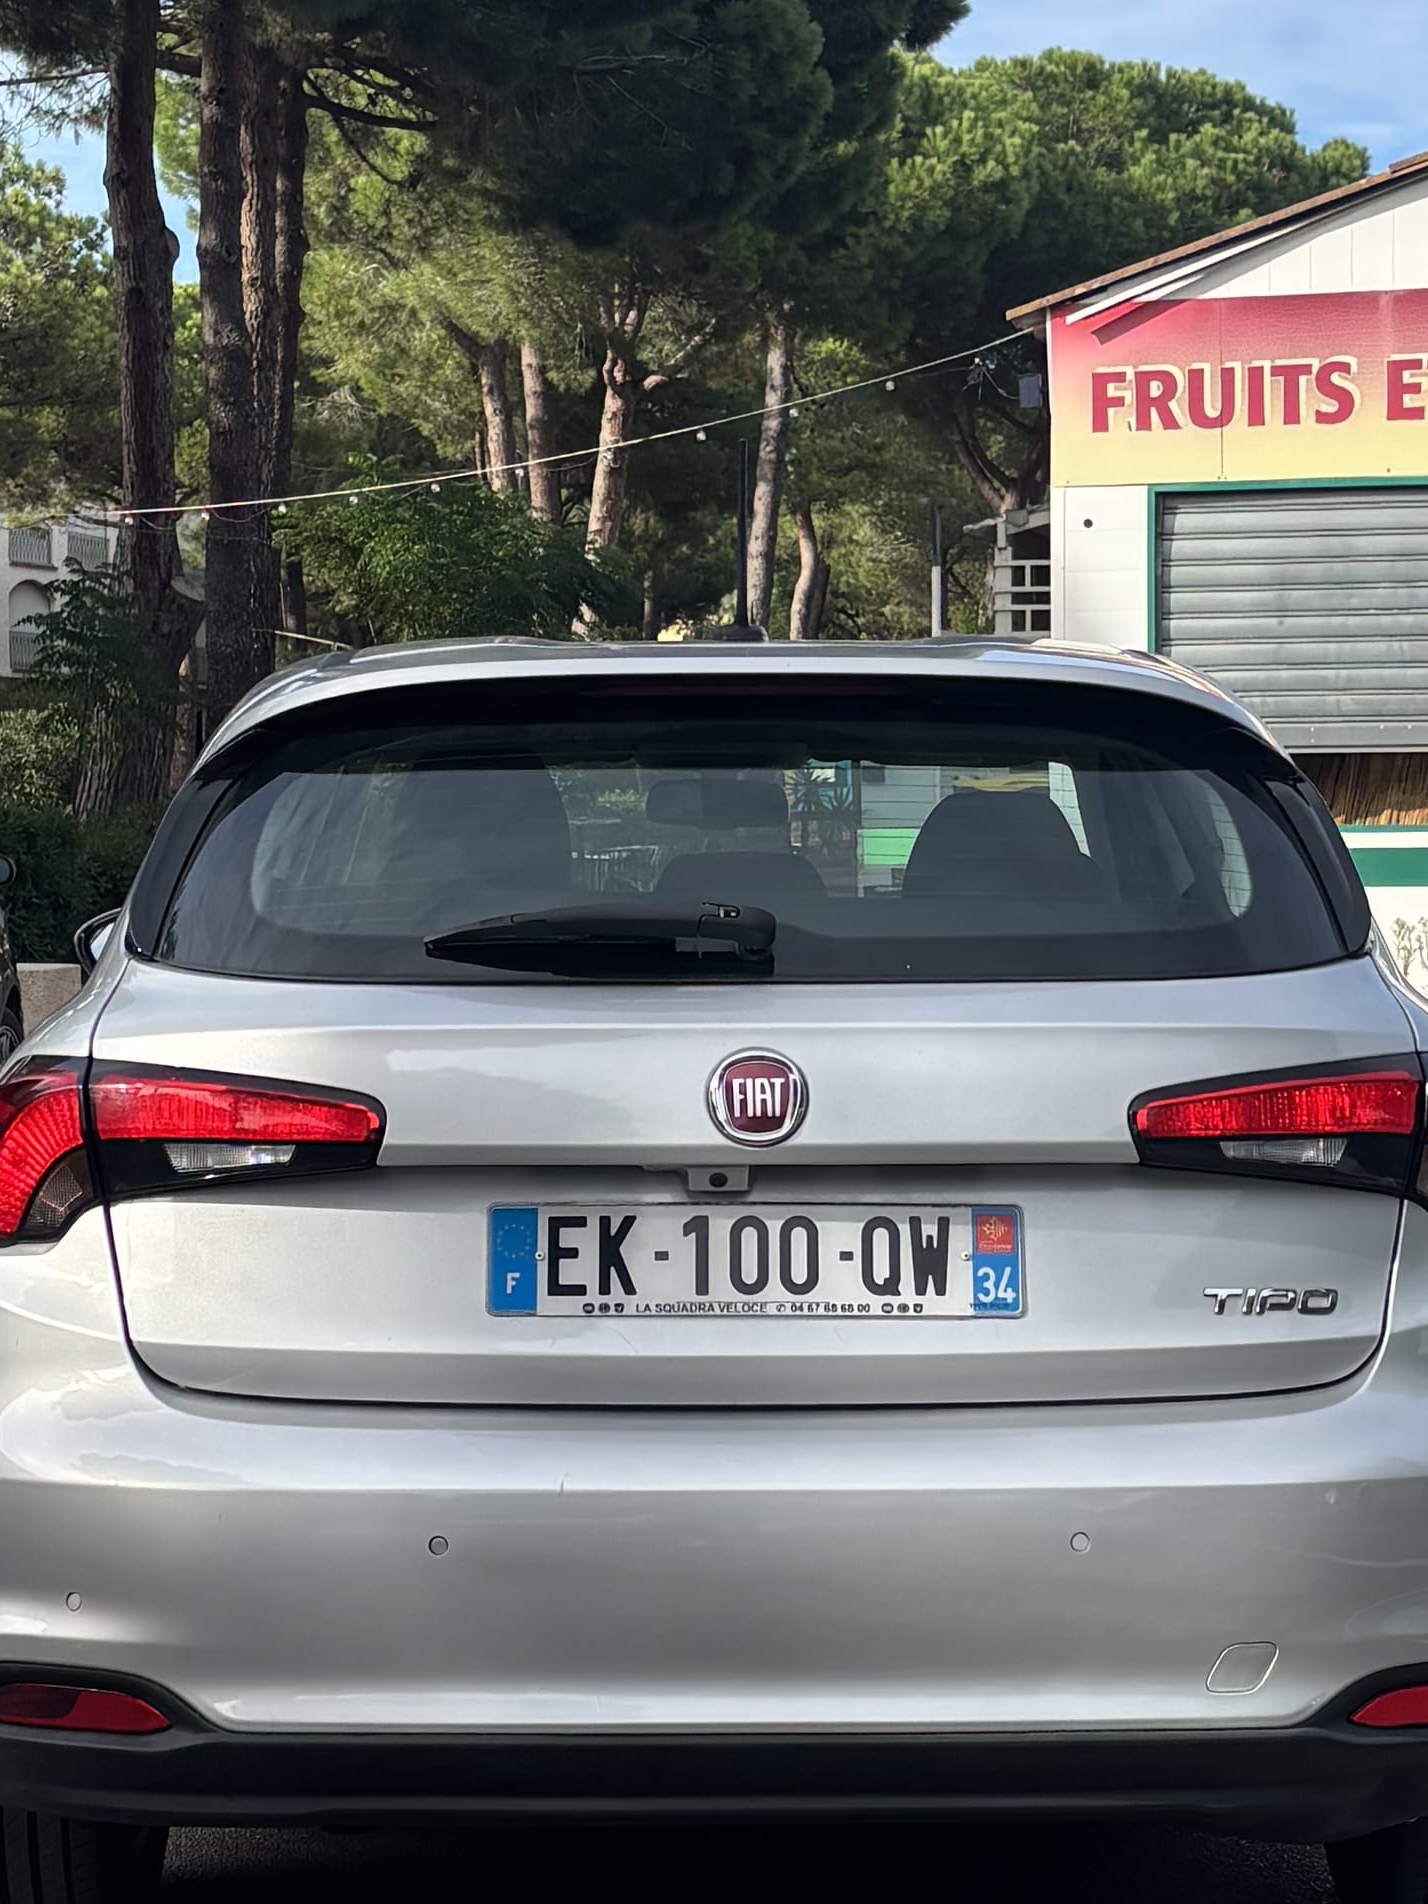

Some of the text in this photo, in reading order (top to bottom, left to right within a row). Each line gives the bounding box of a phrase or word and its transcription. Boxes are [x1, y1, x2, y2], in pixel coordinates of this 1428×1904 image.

[1092, 355, 1358, 433] FRUITS
[732, 1078, 785, 1118] FIAT
[547, 1215, 950, 1296] EK-100-QW
[506, 1273, 520, 1294] F
[977, 1266, 1017, 1303] 34
[1203, 1288, 1338, 1315] TIPO
[636, 1303, 651, 1313] LA
[655, 1303, 715, 1313] SQUADRA
[719, 1303, 767, 1313] VELOCE
